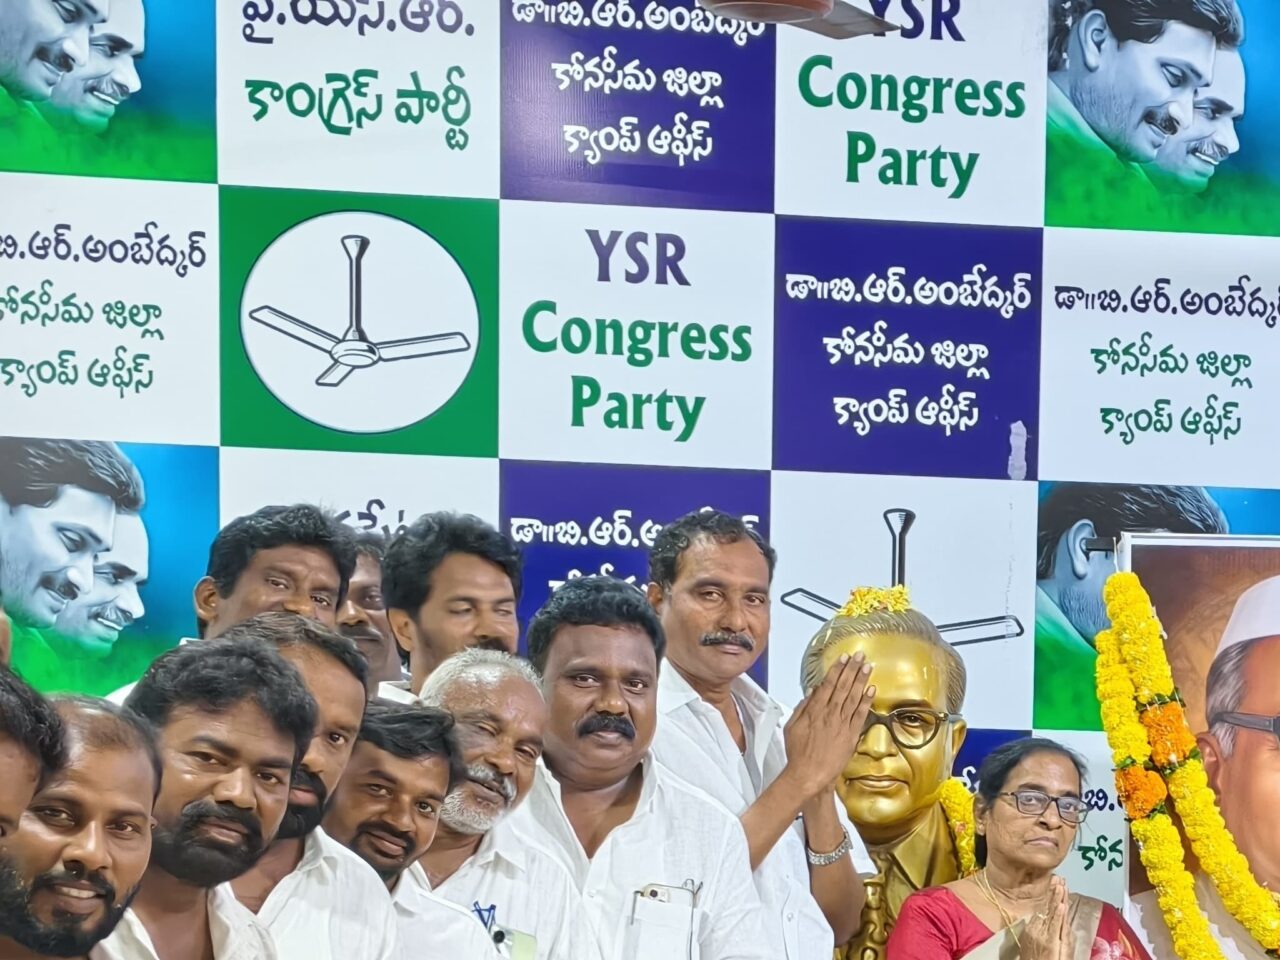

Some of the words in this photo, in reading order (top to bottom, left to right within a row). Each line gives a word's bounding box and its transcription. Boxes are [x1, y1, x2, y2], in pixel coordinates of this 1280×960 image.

[551, 46, 656, 93] కోనసీమ
[662, 66, 725, 109] జిల్లా
[798, 54, 1026, 124] Congress
[244, 68, 383, 136] కాంగ్రెస్
[394, 65, 471, 151] పార్టీ
[563, 117, 641, 164] క్యాంప్
[647, 111, 713, 167] ఆఫీస్
[845, 130, 980, 199] Party
[584, 228, 692, 287] YSR
[101, 300, 165, 341] జిల్లా
[521, 299, 752, 368] Congress
[822, 319, 925, 368] కోనసీమ
[930, 340, 991, 380] జిల్లా
[86, 345, 154, 399] ఆఫీస్
[1090, 331, 1189, 378] కోనసీమ
[1195, 350, 1253, 389] జిల్లా
[570, 375, 707, 443] Party
[832, 388, 909, 436] క్యాంప్
[915, 383, 979, 437] ఆఫీస్
[1099, 398, 1173, 446] క్యాంప్
[1180, 393, 1242, 446] ఆఫీస్
